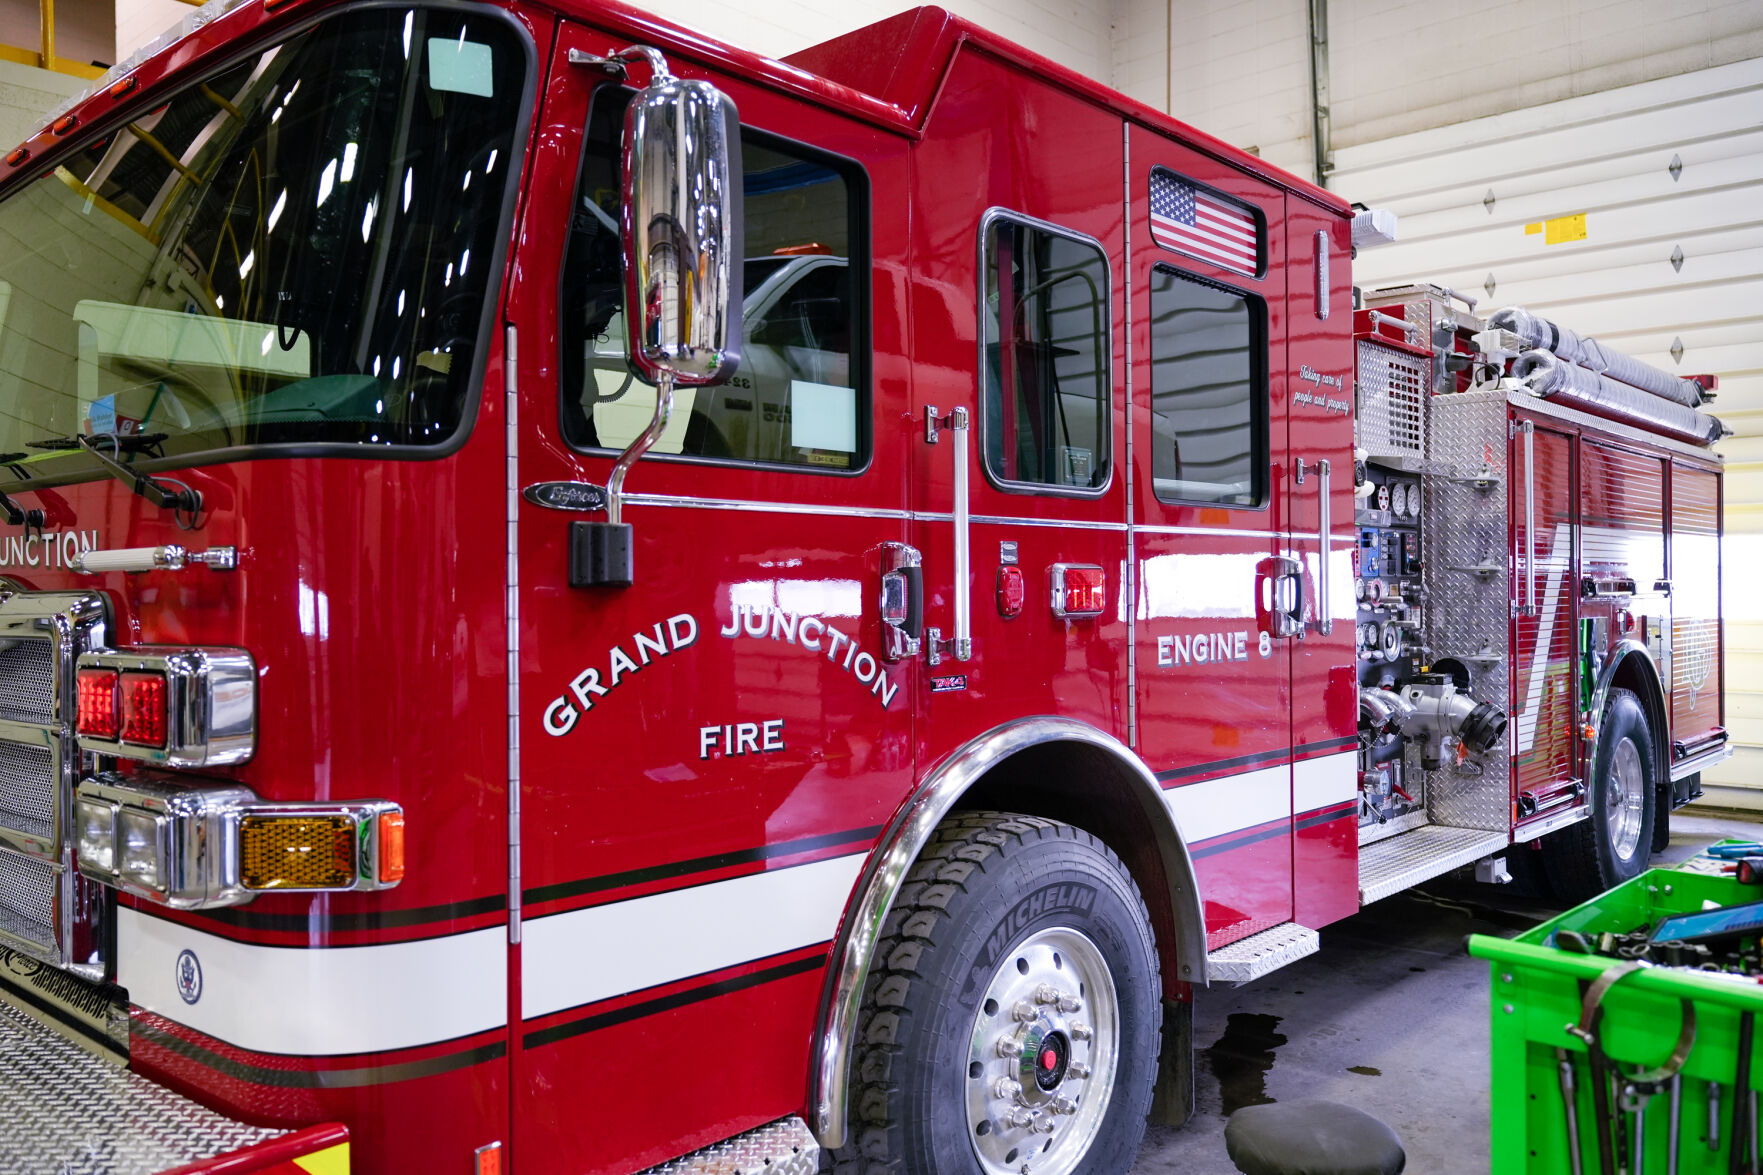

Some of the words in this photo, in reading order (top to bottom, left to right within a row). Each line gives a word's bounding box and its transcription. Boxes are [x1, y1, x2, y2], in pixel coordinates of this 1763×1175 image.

[1300, 364, 1321, 388] Taking
[1322, 374, 1335, 387] care
[1336, 374, 1344, 392] of
[1293, 389, 1313, 408] people
[1314, 393, 1327, 407] and
[1326, 399, 1349, 416] property
[1157, 630, 1249, 668] ENGINE
[1258, 630, 1272, 660] 8
[543, 613, 700, 737] GRAND
[721, 604, 899, 711] JUNCTION
[700, 718, 787, 761] FIRE
[986, 885, 1097, 963] MICHELIN
